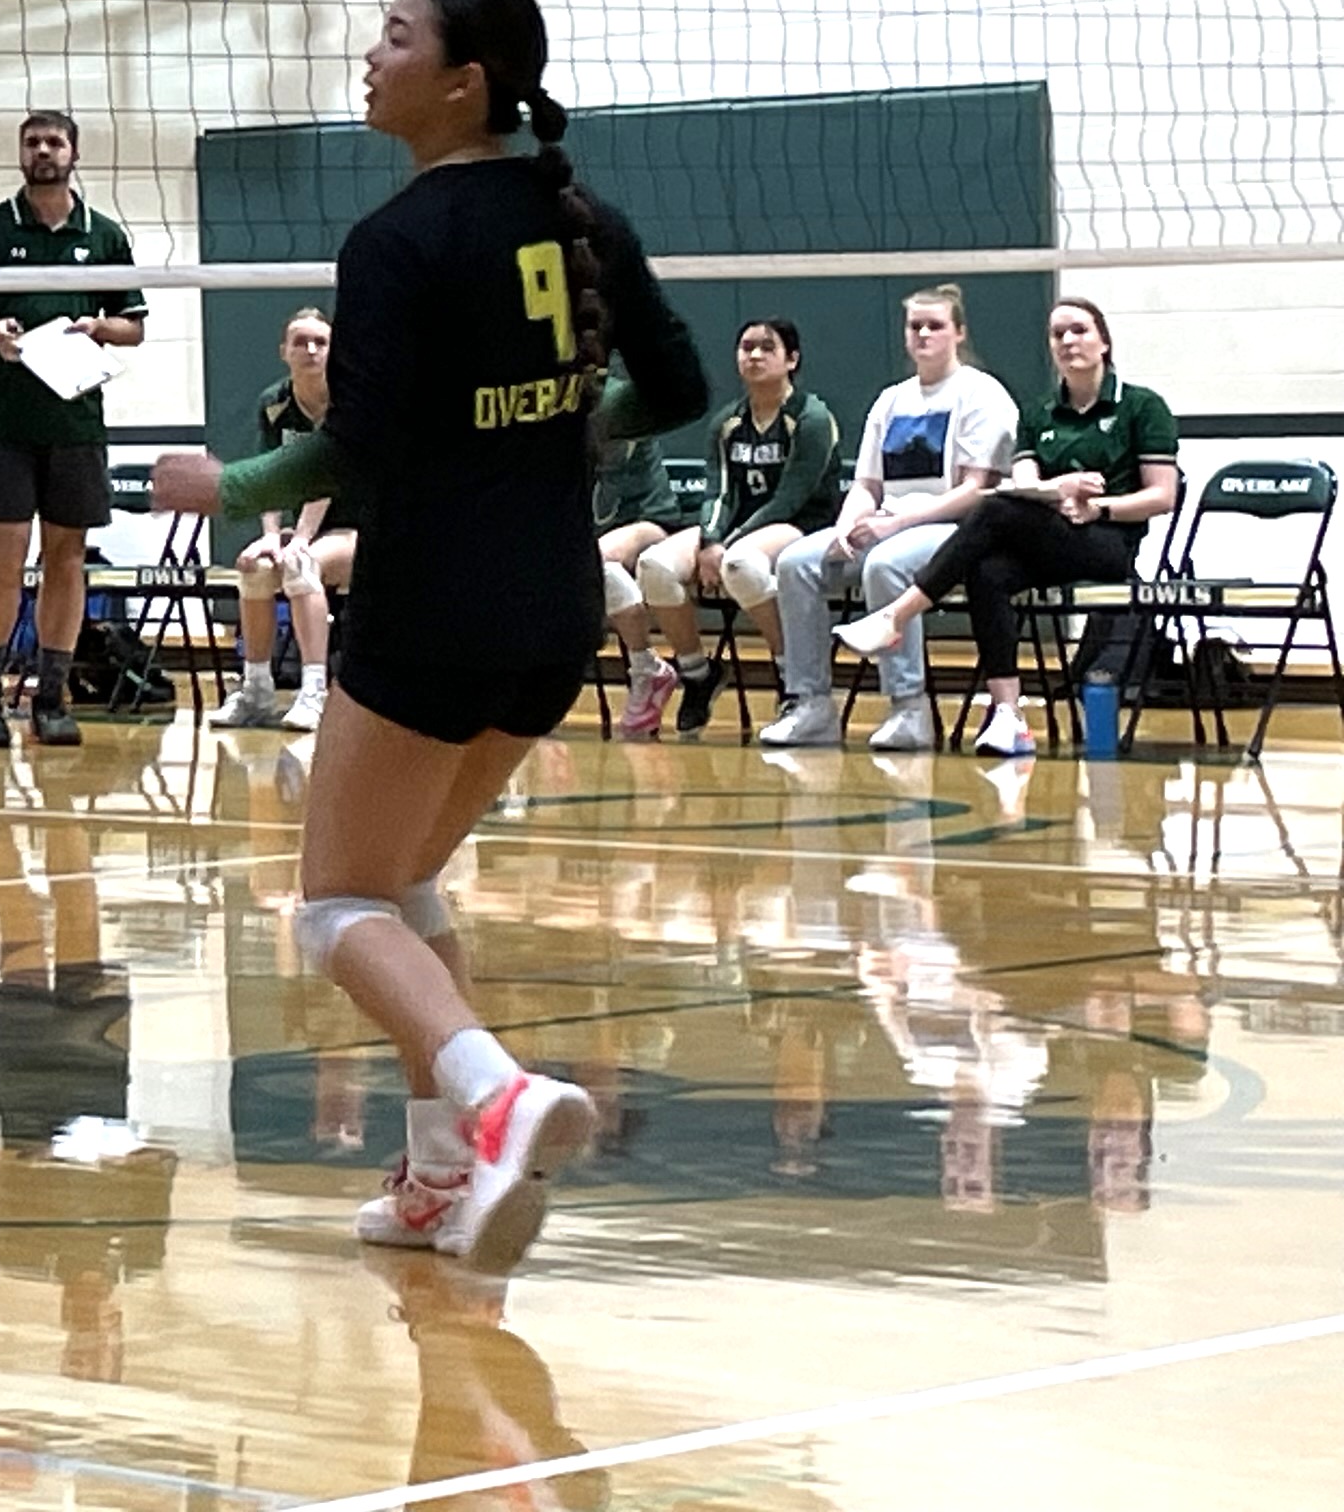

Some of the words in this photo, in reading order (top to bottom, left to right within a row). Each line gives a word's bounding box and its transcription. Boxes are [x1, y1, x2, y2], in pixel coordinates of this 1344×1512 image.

[517, 241, 576, 362] 9
[141, 568, 196, 585] OWLS
[1138, 584, 1212, 606] OWLS
